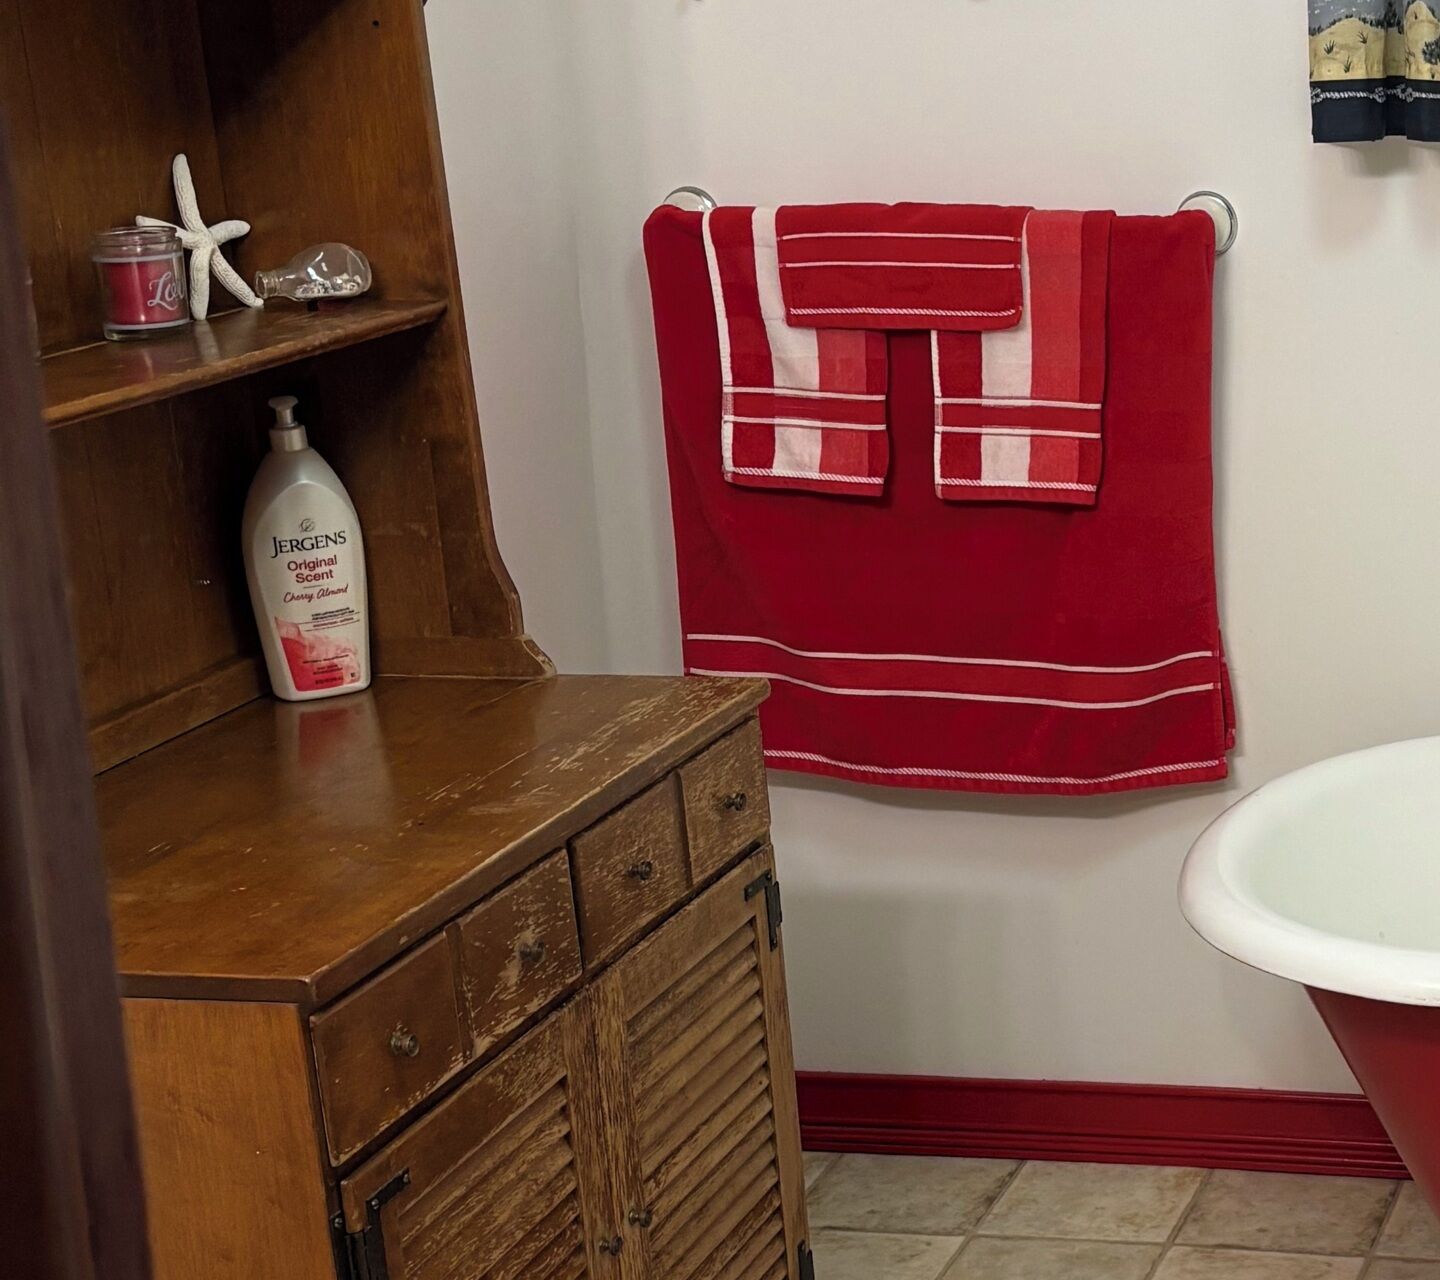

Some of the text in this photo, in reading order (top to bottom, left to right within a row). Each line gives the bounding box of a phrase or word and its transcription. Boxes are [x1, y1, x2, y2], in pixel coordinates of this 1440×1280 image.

[271, 530, 347, 559] JERGENS
[287, 555, 338, 572] Original
[295, 569, 334, 584] Scent
[283, 583, 349, 603] Cherry Almond
